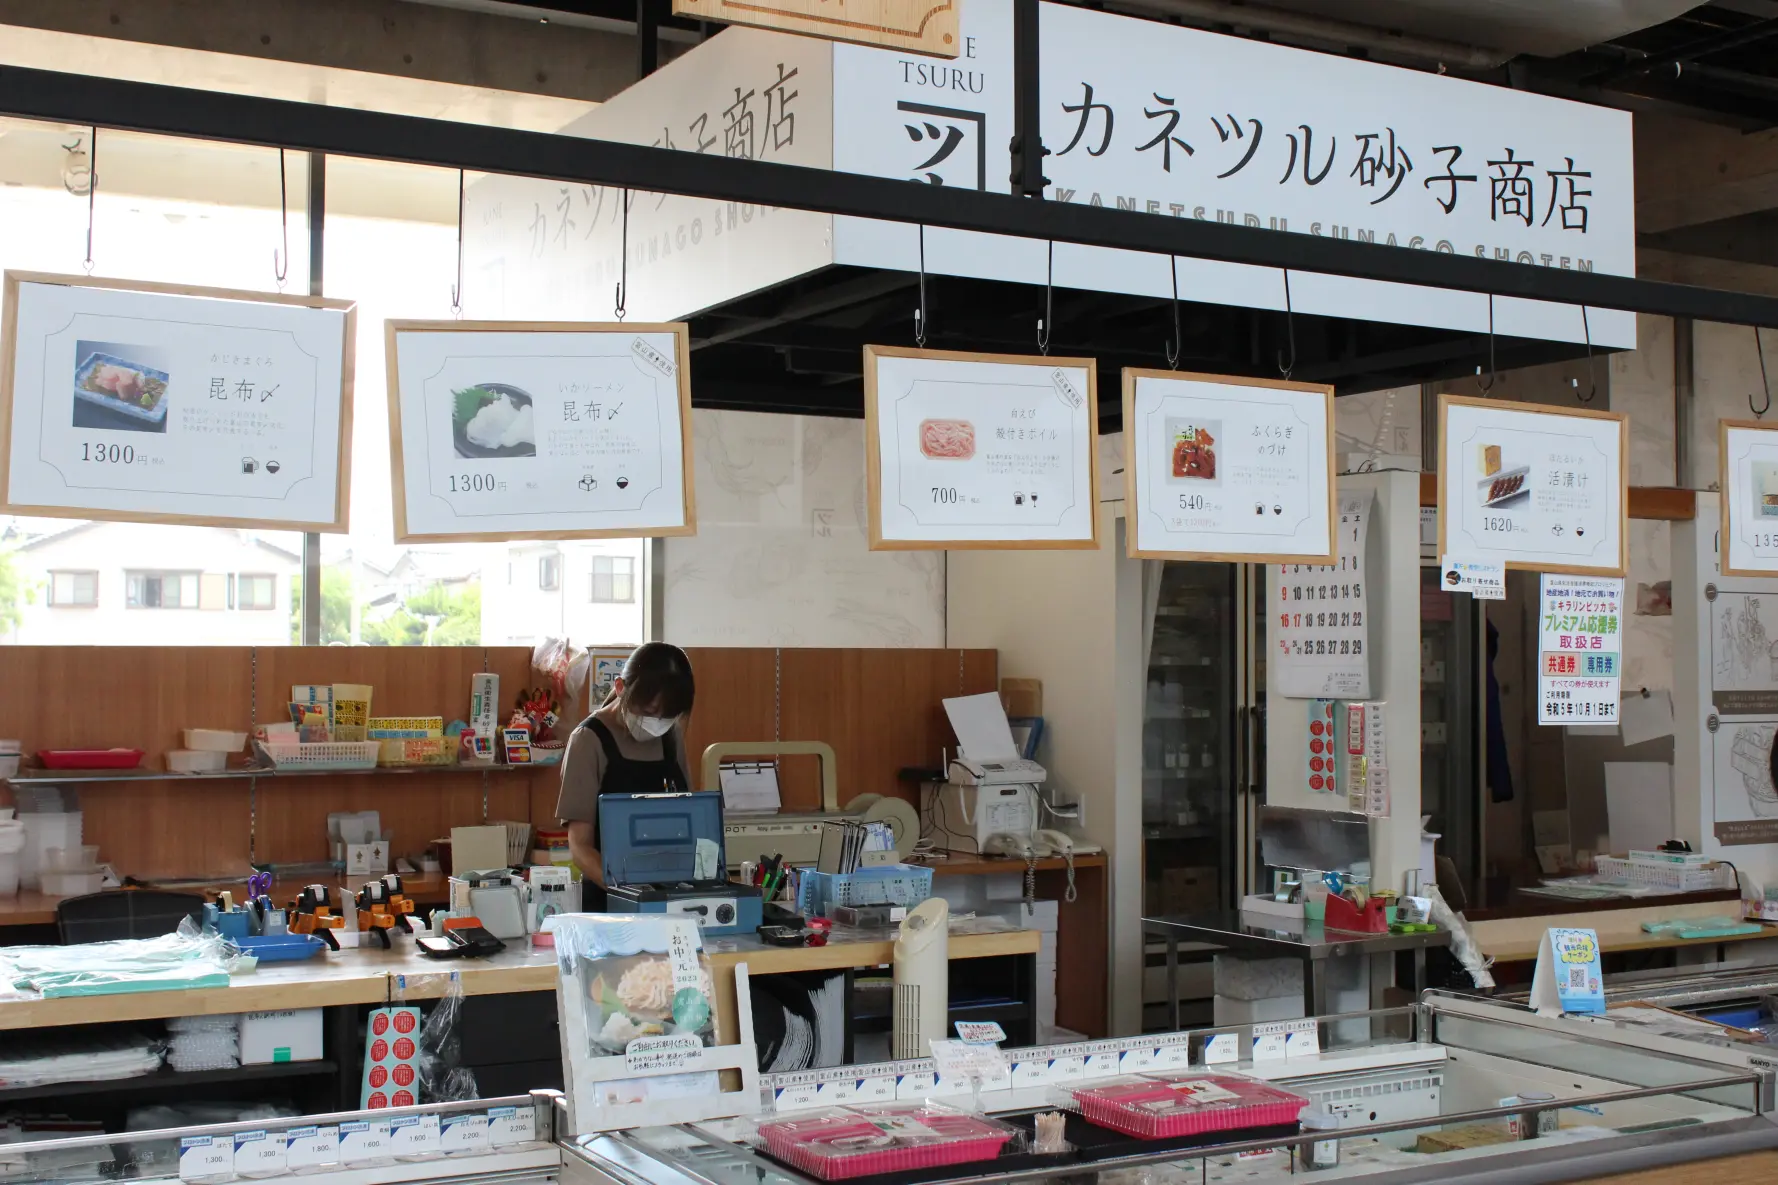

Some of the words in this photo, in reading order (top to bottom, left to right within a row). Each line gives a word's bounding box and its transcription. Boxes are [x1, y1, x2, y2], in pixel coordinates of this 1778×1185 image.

[898, 60, 985, 94] TSURU
[1055, 81, 1593, 234] カネツル砂子商店
[209, 377, 280, 402] 昆布〆
[563, 400, 623, 421] 昆布〆
[1252, 425, 1293, 440] ふくらぎ
[1353, 527, 1358, 542] 1
[1341, 557, 1346, 571] 7
[1352, 556, 1358, 571] 8
[1281, 586, 1287, 601] 9
[1293, 586, 1302, 601] 10
[1306, 586, 1314, 600] 11
[1318, 585, 1327, 600] 12
[1330, 585, 1338, 599] 13
[1341, 584, 1349, 599] 14
[1352, 583, 1361, 598] 15
[1280, 613, 1289, 628] 16
[1293, 613, 1302, 628] 17
[1305, 613, 1313, 627] 18
[1317, 612, 1325, 627] 19
[1328, 612, 1338, 627] 20
[1341, 612, 1350, 627] 21
[1352, 611, 1362, 627] 22
[1544, 613, 1618, 634] プレミアム応援券
[1304, 640, 1313, 655] 25
[1316, 640, 1325, 655] 26
[1328, 640, 1337, 655] 27
[1340, 640, 1349, 655] 28
[1352, 639, 1362, 655] 29
[1559, 635, 1602, 649] 取扱店
[1548, 656, 1575, 673] 共通券
[1587, 656, 1612, 674] 専用券
[675, 974, 698, 983] 2023
[1750, 1058, 1770, 1068] SANYO
[462, 1132, 479, 1140] 2,200
[205, 1156, 223, 1164] 1,300
[259, 1150, 276, 1158] 1,300
